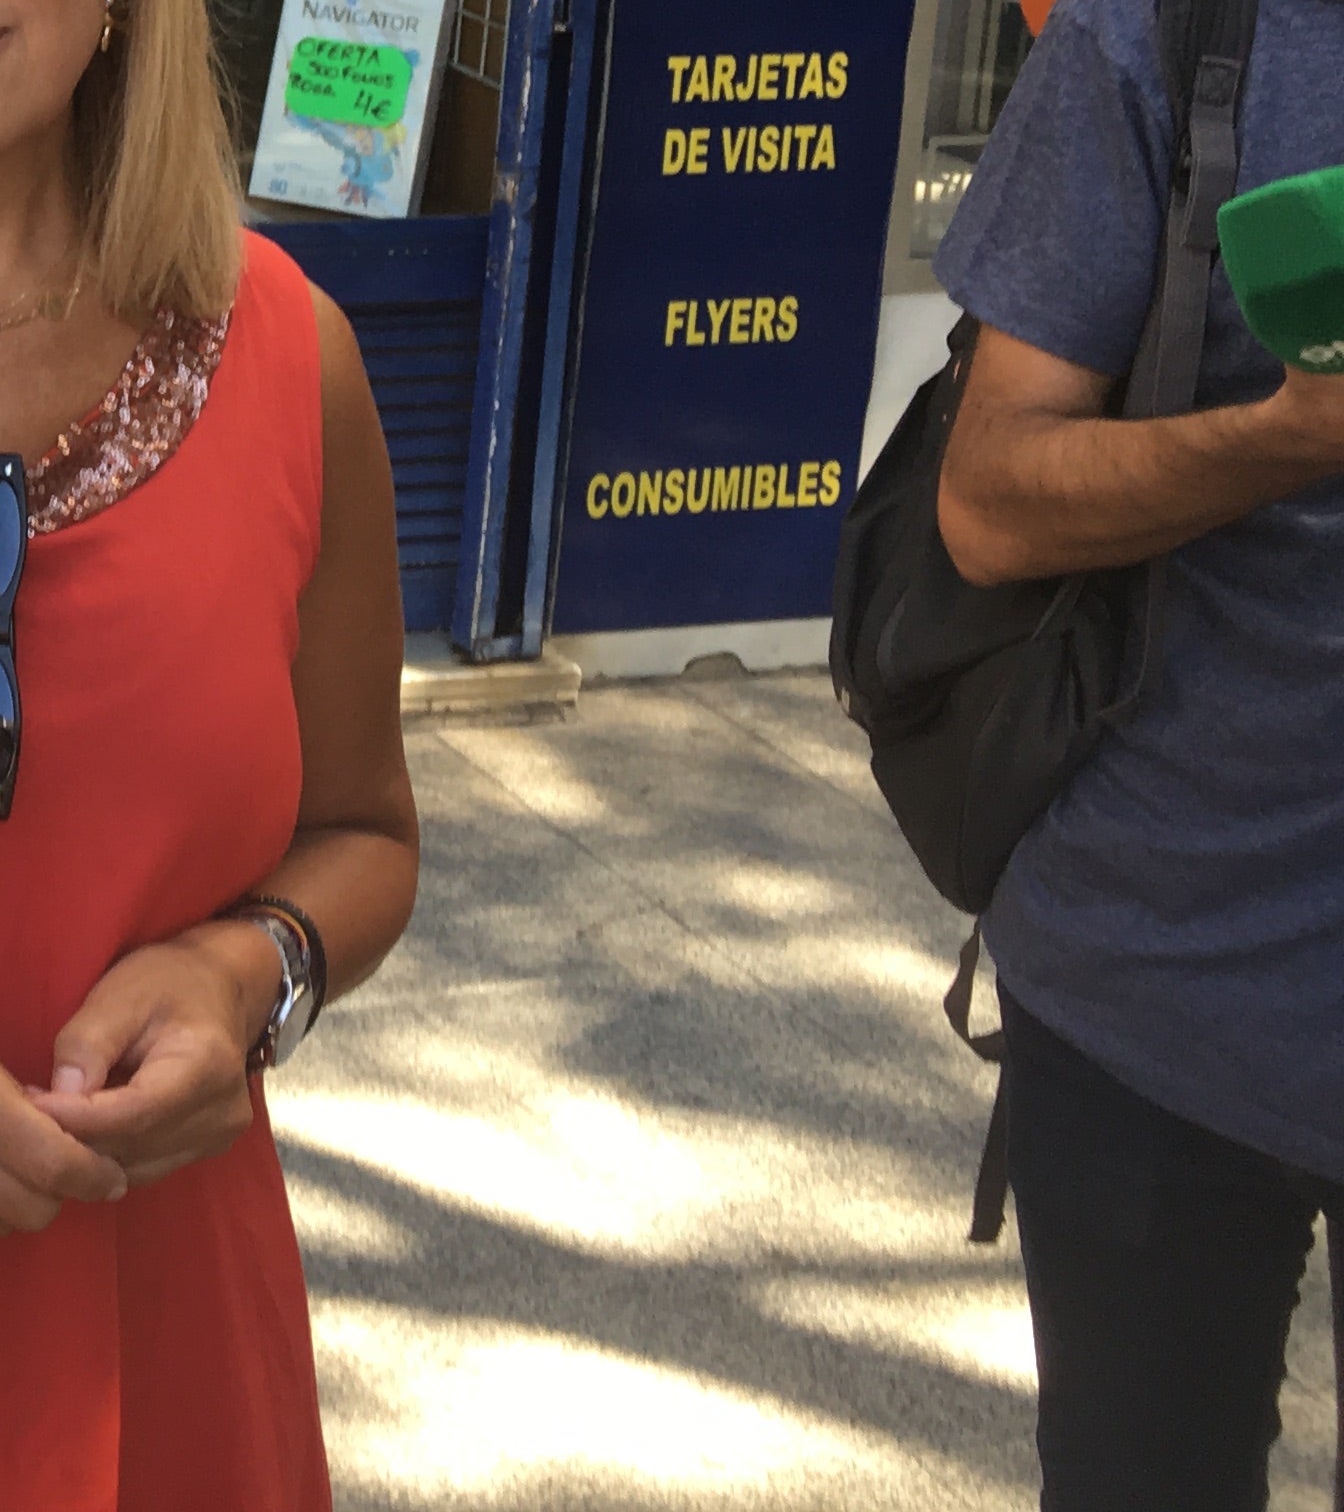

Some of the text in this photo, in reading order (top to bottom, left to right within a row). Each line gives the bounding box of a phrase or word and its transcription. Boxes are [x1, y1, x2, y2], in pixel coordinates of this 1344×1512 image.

[297, 37, 381, 66] OFERTA
[668, 51, 849, 102] TARJETAS
[662, 124, 835, 176] DE VISITA
[664, 296, 798, 346] FLYERS
[586, 460, 841, 520] CONSUMIBLES
